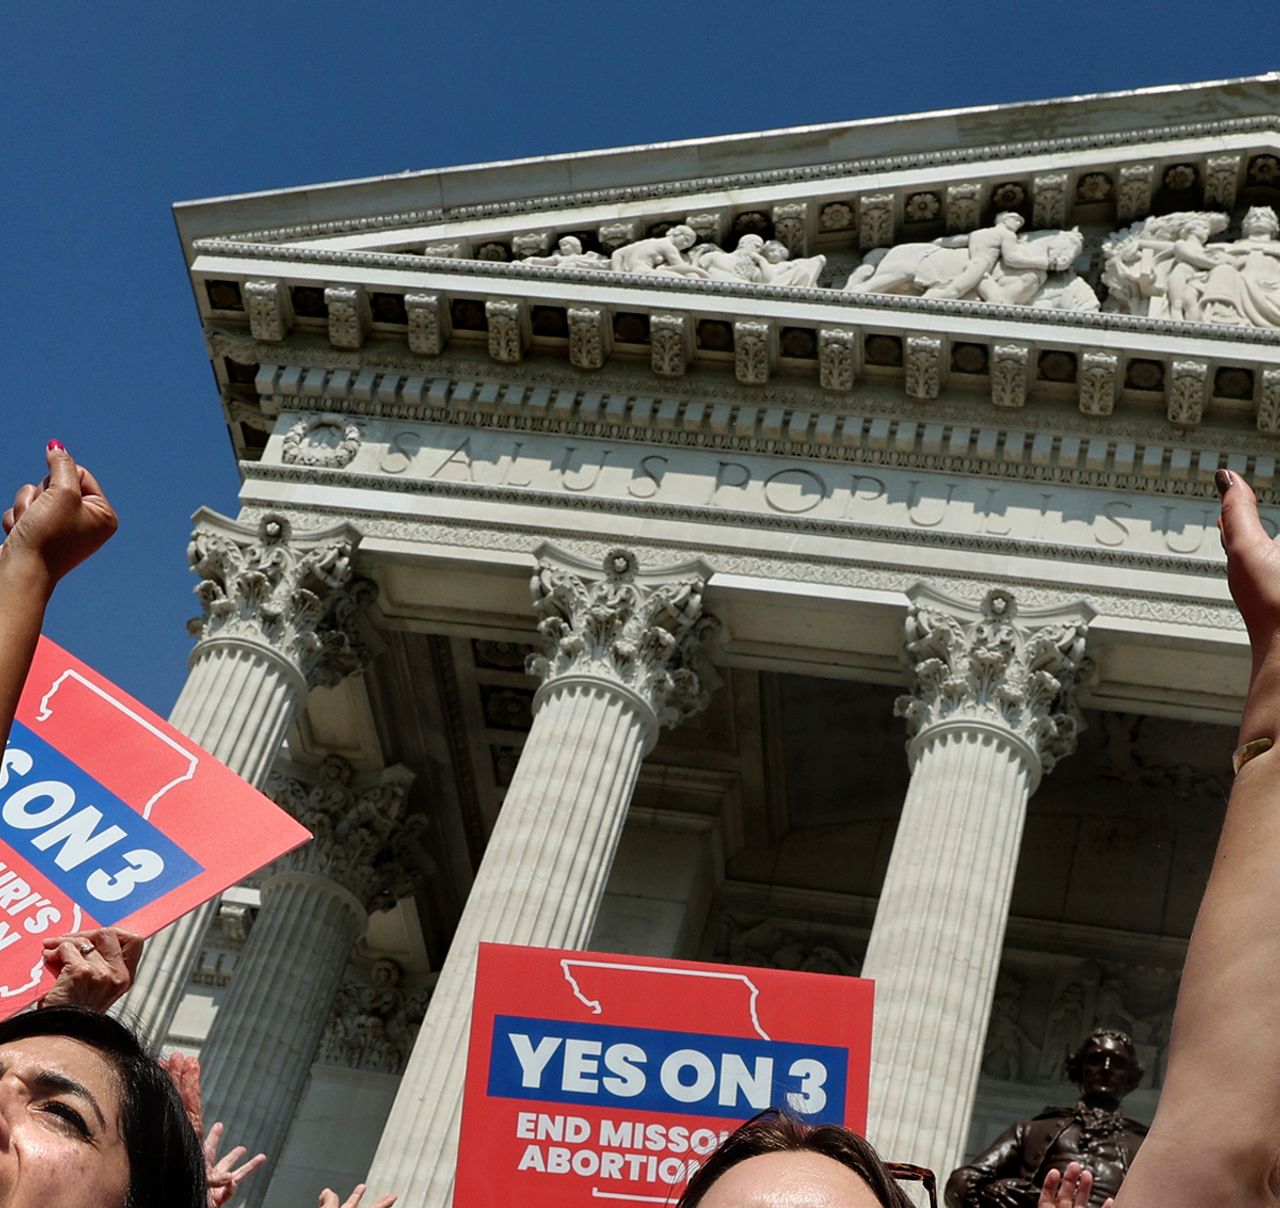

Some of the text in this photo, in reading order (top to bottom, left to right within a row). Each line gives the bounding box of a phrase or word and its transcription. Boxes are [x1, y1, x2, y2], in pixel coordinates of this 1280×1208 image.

[379, 431, 668, 499] SALUS
[707, 461, 1054, 540] POPULI
[2, 780, 165, 901] ON 3
[509, 1033, 828, 1114] YES ON 3
[516, 1112, 591, 1144] END
